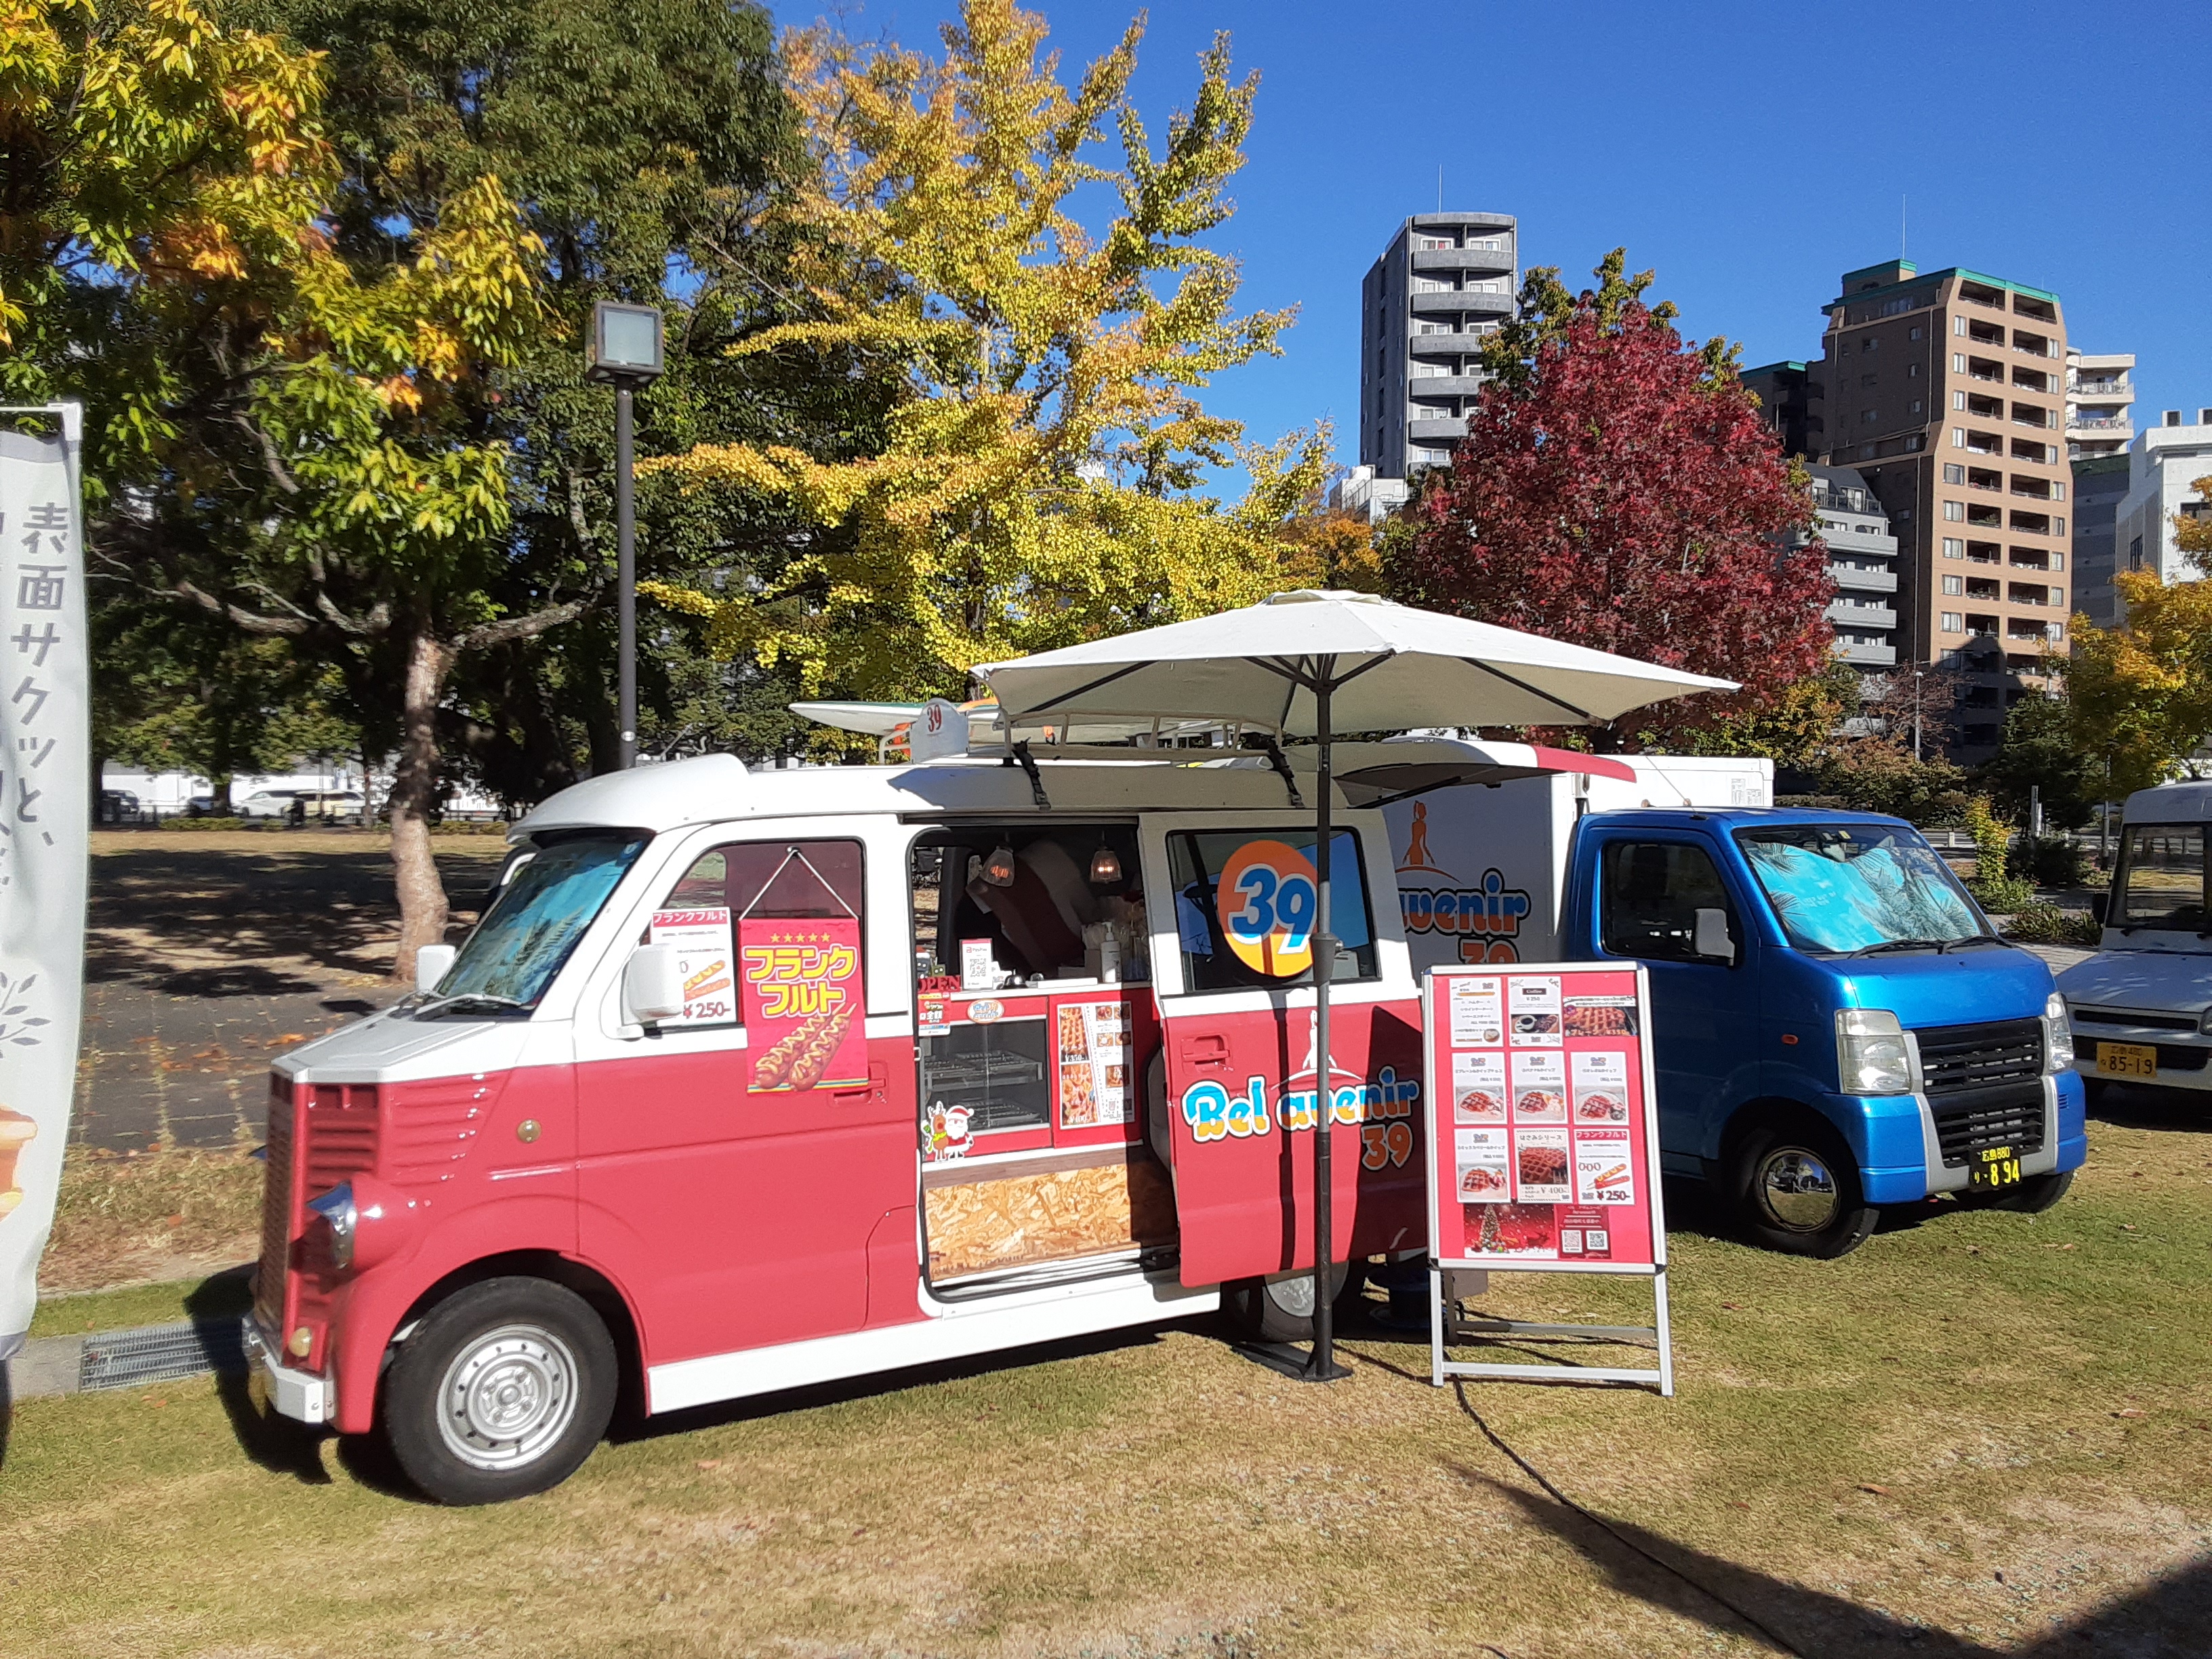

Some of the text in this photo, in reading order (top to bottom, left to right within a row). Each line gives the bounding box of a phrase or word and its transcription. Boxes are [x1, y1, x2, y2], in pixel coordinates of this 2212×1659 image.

[11, 502, 68, 846] 表面サクッと、
[926, 704, 941, 732] 39
[653, 911, 726, 924] フランクフルト
[1228, 863, 1317, 954] 39
[1399, 870, 1529, 935] venir
[743, 945, 857, 981] フランク
[759, 981, 844, 1017] フルト
[2110, 1056, 2152, 1074] 85-19
[1183, 1077, 1271, 1143] Bel
[1362, 1122, 1413, 1171] 39
